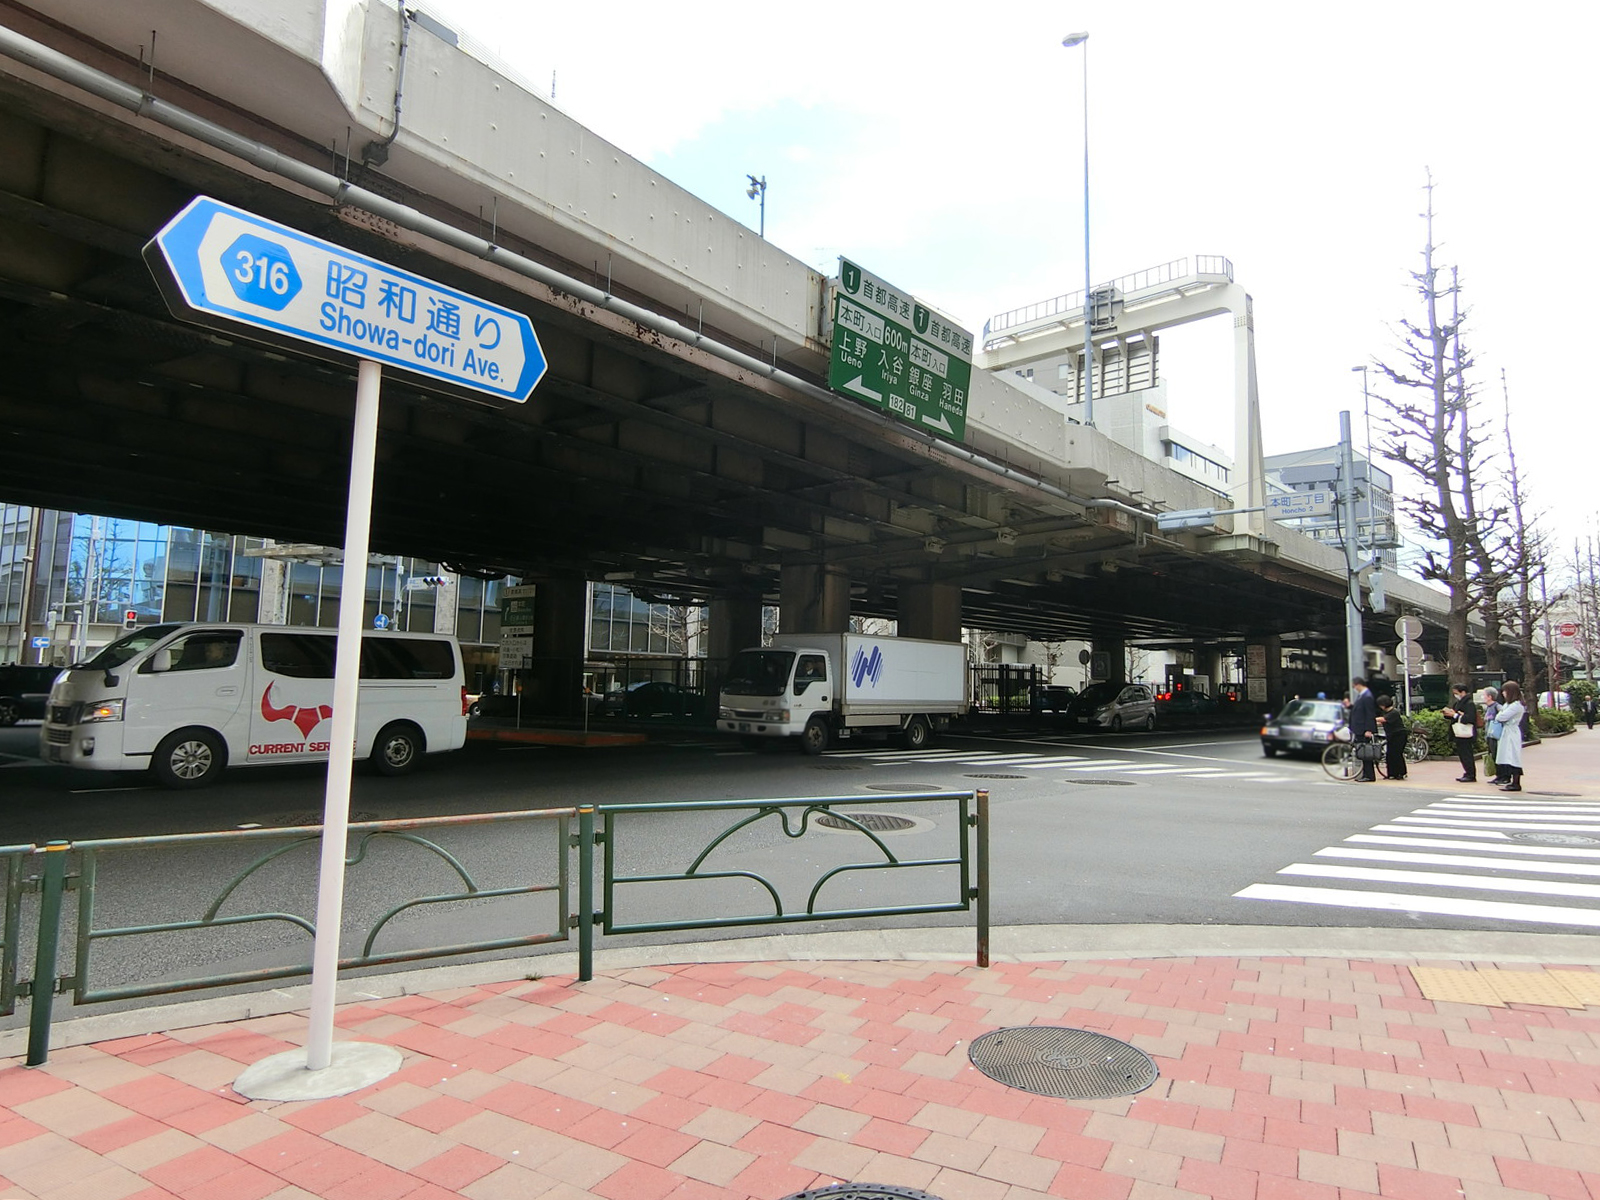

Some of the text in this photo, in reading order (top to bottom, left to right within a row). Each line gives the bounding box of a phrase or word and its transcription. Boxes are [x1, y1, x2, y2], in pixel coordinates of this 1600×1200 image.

[234, 250, 289, 296] 316
[326, 259, 502, 351] 昭和通り
[863, 279, 910, 321] 首都高速
[319, 302, 504, 382] Showa-dori Ave.
[840, 304, 908, 354] 本町入口 600m
[930, 319, 971, 356] 首都高速
[839, 331, 904, 376] 上野 入谷
[840, 350, 898, 385] Ueno Iriya
[909, 366, 964, 407] 銀座 羽田
[909, 385, 964, 417] Ginza Haneda
[905, 403, 915, 419] 81
[1270, 493, 1325, 508] 本町二丁目
[249, 742, 306, 755] CURRENT
